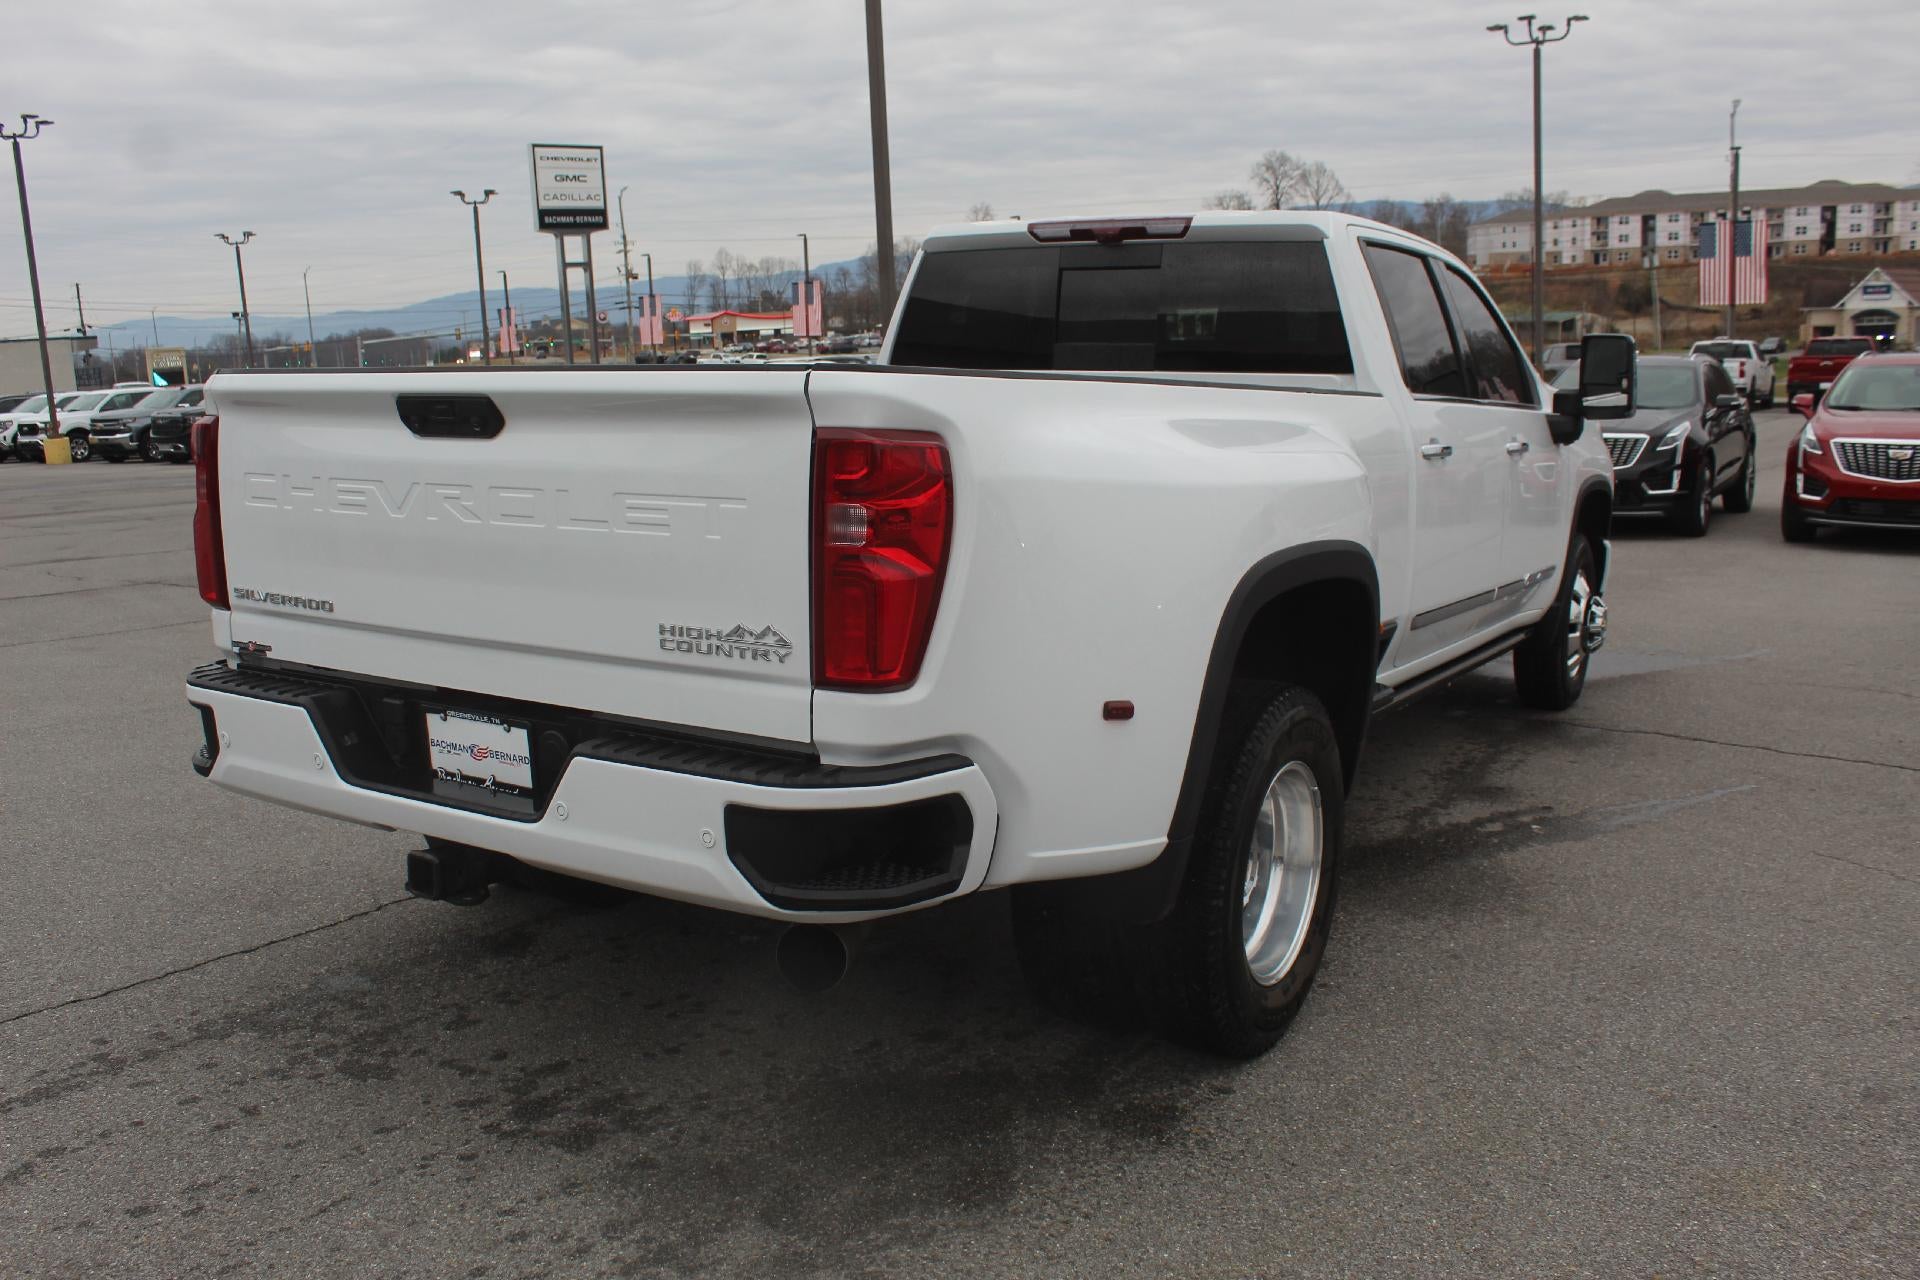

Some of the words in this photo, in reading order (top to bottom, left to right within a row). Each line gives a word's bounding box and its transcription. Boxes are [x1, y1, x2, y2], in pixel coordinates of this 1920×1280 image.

[554, 174, 588, 183] GMC
[543, 193, 601, 201] CADILLAC
[244, 472, 748, 539] CHEVROLET
[233, 587, 334, 613] SILVERADO
[659, 623, 723, 641] HIGH
[659, 637, 792, 663] COUNTRY
[430, 738, 469, 754] BACHMAN
[489, 749, 530, 765] BERNARD
